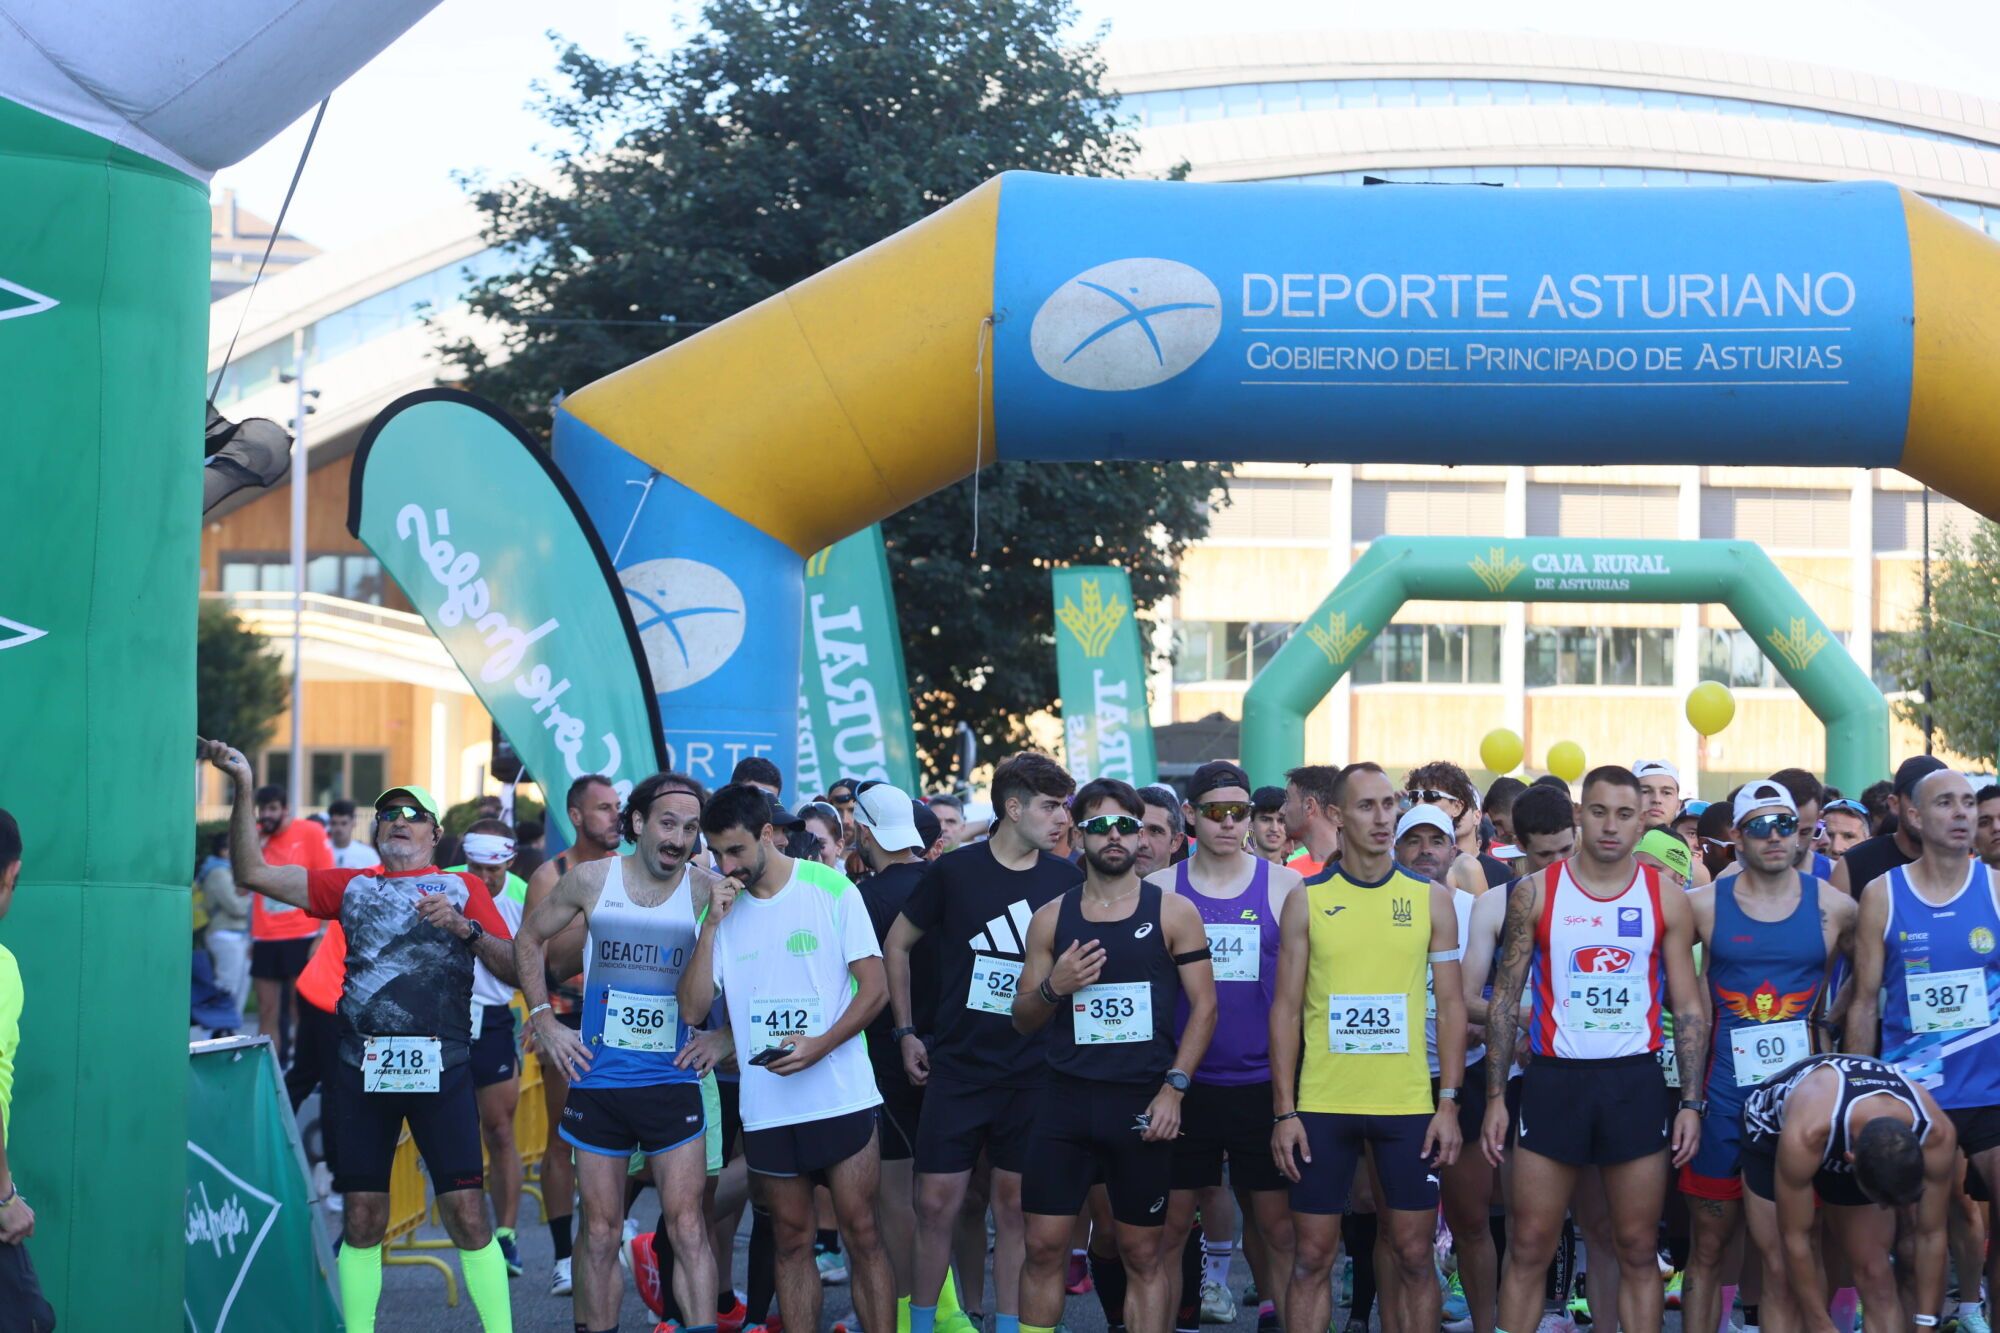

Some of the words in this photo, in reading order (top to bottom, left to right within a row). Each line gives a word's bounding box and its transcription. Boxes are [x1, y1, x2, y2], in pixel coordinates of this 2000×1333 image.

[1243, 273, 1509, 318] DEPORTE
[1528, 271, 1856, 319] ASTURIANO
[1246, 342, 1398, 371] GOBIERNO
[1406, 347, 1459, 371] DEL
[1466, 343, 1637, 371] PRINCIPADO
[1645, 347, 1682, 371] DE
[1693, 342, 1844, 371] ASTURIAS
[1532, 553, 1588, 574] CAJA
[1592, 554, 1671, 574] RURAL
[1535, 578, 1555, 590] DE
[1558, 578, 1630, 591] ASTURIAS
[628, 963, 658, 972] ESPECTRO
[987, 971, 1020, 992] 52
[990, 990, 1012, 999] FABIO
[1585, 987, 1630, 1007] 514
[1924, 984, 1969, 1008] 387
[621, 1006, 664, 1028] 356
[1090, 997, 1134, 1018] 353
[1345, 1007, 1390, 1028] 243
[1592, 1007, 1623, 1015] QUIQUE
[765, 1009, 808, 1030] 412
[1103, 1018, 1122, 1026] TITO
[631, 1027, 652, 1035] CHUS
[1756, 1036, 1785, 1058] 60
[381, 1050, 424, 1068] 218
